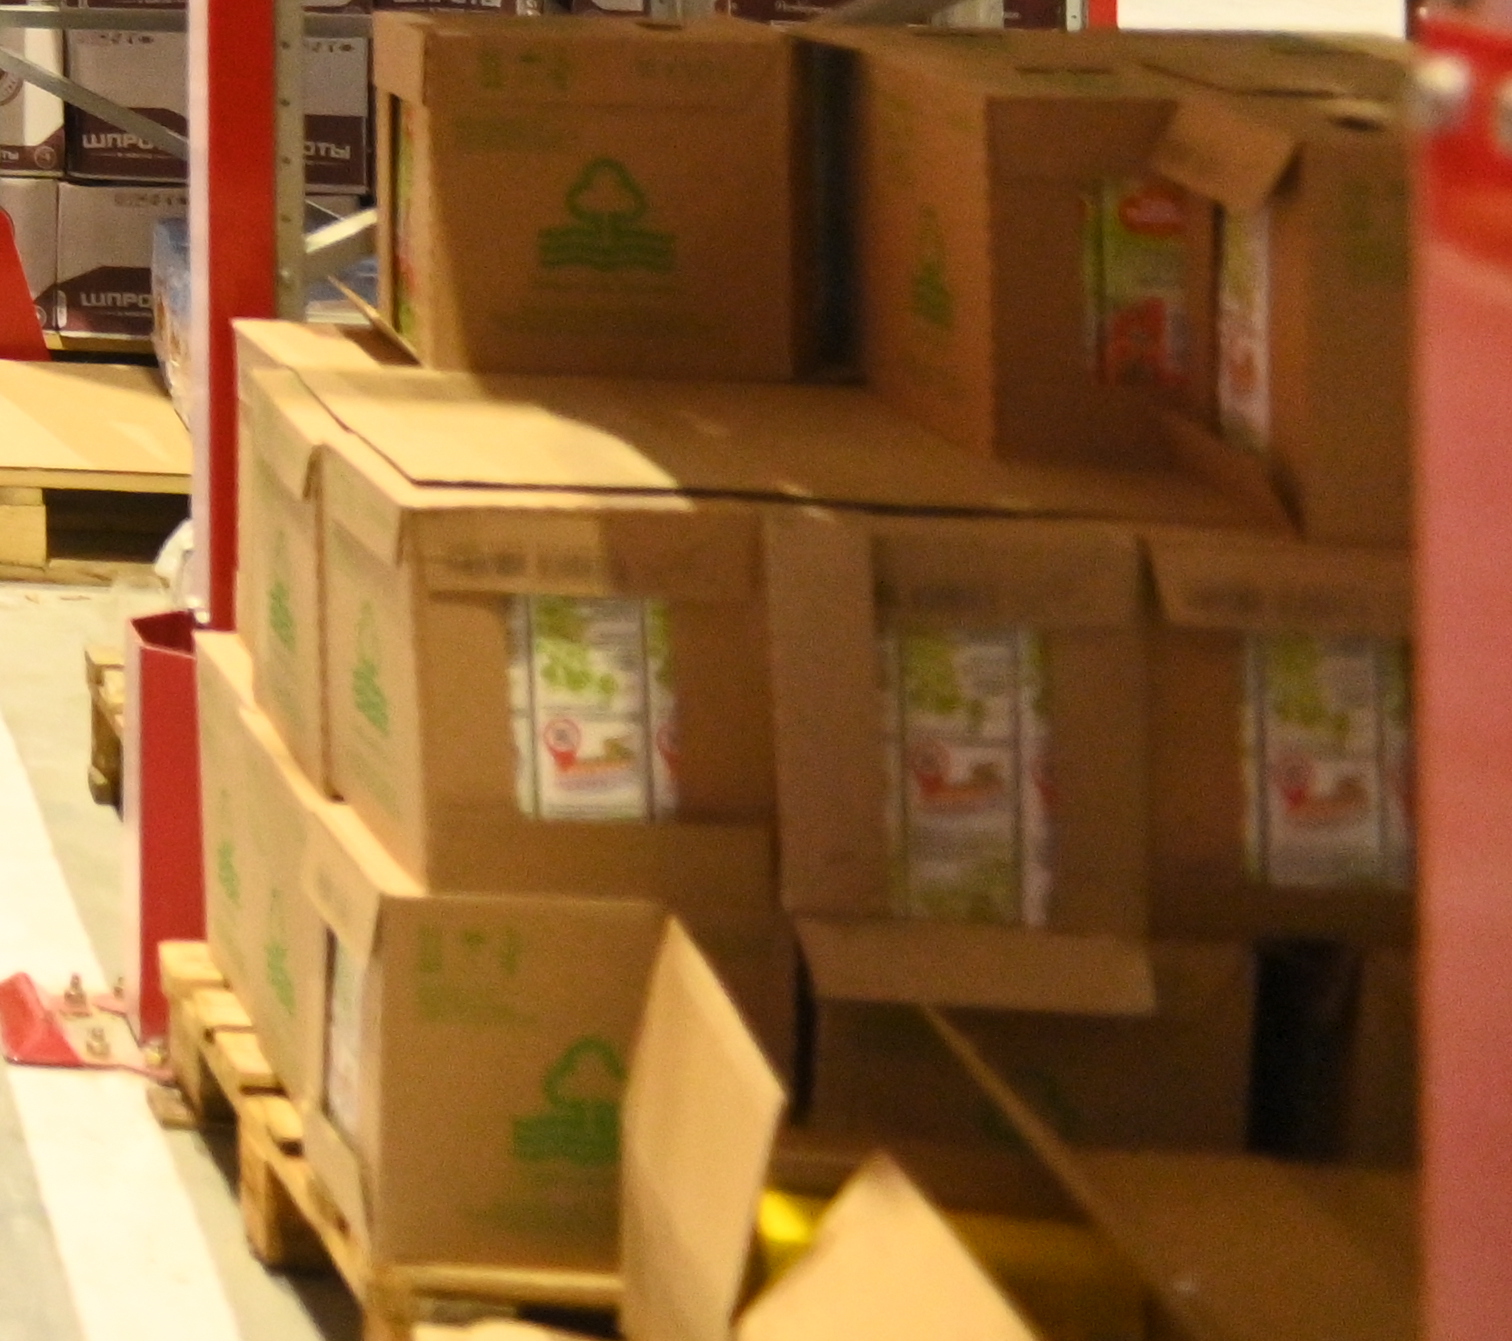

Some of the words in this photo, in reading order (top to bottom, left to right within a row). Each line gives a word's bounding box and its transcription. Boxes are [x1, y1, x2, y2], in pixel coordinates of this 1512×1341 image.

[82, 132, 154, 150] ШПРО
[304, 142, 352, 160] ОТЫ
[80, 292, 154, 308] ШПРО
